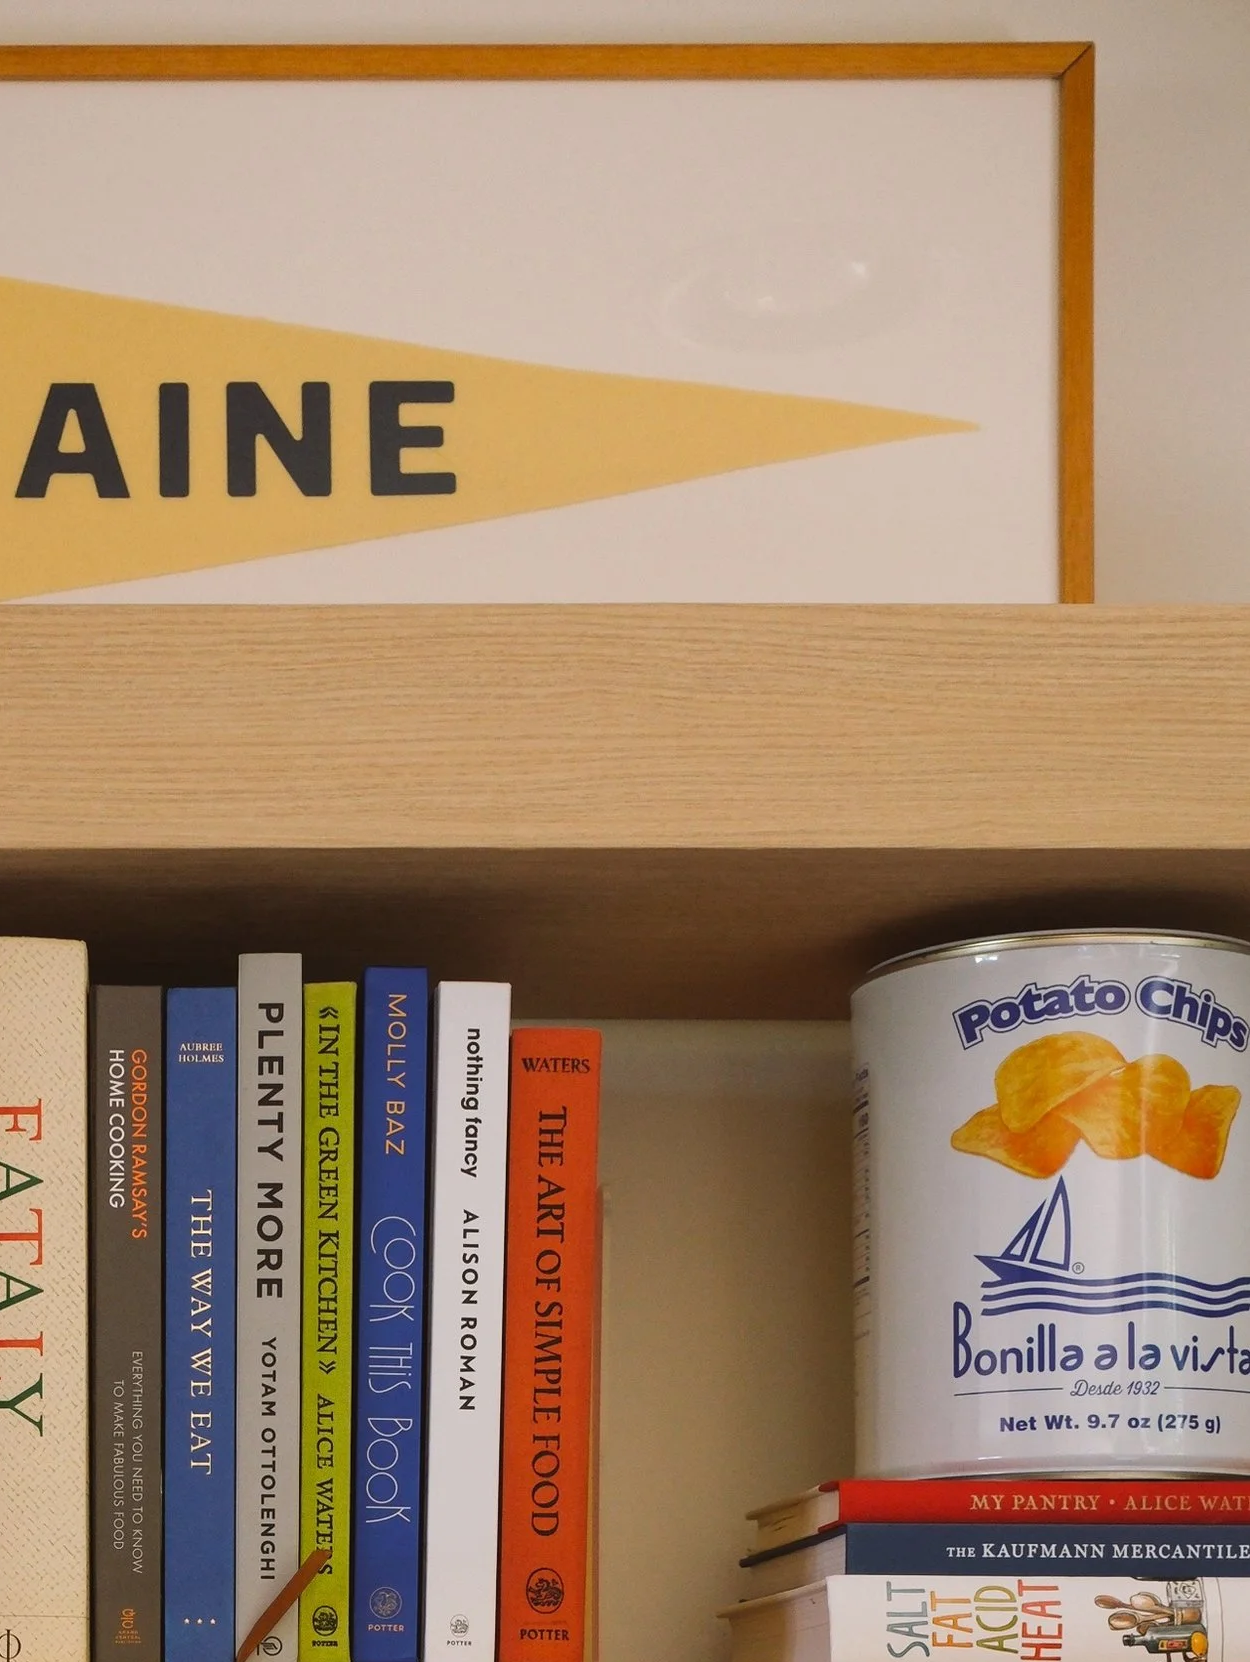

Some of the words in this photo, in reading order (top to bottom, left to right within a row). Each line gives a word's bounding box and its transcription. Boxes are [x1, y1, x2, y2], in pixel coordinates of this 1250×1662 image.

[386, 993, 407, 1089] MOLLY
[953, 974, 1130, 1051] Potato
[1134, 974, 1249, 1052] Chips
[109, 1049, 125, 1108] HOME
[177, 1054, 225, 1063] HOLMES
[178, 1043, 223, 1052] AUBREE
[461, 1027, 484, 1112] nothing
[521, 1057, 591, 1074] WATERS
[131, 1049, 147, 1139] GORDON
[257, 1003, 284, 1162] PLENTY
[318, 1061, 340, 1118] THE
[385, 1100, 406, 1155] BAZ
[460, 1117, 479, 1179] fancy
[537, 1105, 568, 1169] THE
[109, 1114, 125, 1209] COOKING
[131, 1143, 147, 1239] RAMSAY'S
[317, 1127, 340, 1221] GREEN
[190, 1189, 213, 1259] THE
[256, 1183, 283, 1299] MORE
[536, 1175, 566, 1244] ART
[461, 1208, 479, 1305] ALISON
[535, 1249, 563, 1293] OF
[190, 1268, 212, 1338] WAY
[459, 1316, 477, 1411] ROMAN
[532, 1300, 563, 1424] SIMPLE
[953, 1300, 1084, 1378] Bonilla
[1093, 1345, 1118, 1371] a
[1127, 1321, 1162, 1372] la
[113, 1379, 125, 1398] TO
[132, 1350, 143, 1430] EVERYTHING
[190, 1347, 212, 1398] WE
[261, 1336, 277, 1416] YOTAM
[1069, 1379, 1124, 1397] Desde
[1126, 1380, 1161, 1396] 1932
[113, 1403, 124, 1437] MAKE
[132, 1433, 143, 1463] YOU
[189, 1411, 212, 1476] EAT
[316, 1393, 334, 1469] ALICE
[999, 1416, 1037, 1432] Net
[1044, 1415, 1080, 1430] Wt.
[1086, 1414, 1120, 1429] 9.7
[1127, 1416, 1151, 1429] oz
[1157, 1414, 1200, 1433] (275
[1205, 1416, 1222, 1435] g)
[113, 1442, 124, 1507] FABULOUS
[132, 1467, 143, 1502] NEED
[260, 1428, 277, 1580] OTTOLENGHI
[531, 1432, 561, 1538] FOOD
[969, 1494, 1003, 1511] MY
[1012, 1494, 1100, 1511] PANTRY
[1124, 1495, 1192, 1511] ALICE
[113, 1510, 124, 1551] FOOD
[132, 1504, 143, 1525] TO
[132, 1528, 143, 1575] KNOW
[946, 1546, 976, 1558] THE
[981, 1543, 1106, 1559] KAUFMANN
[1111, 1543, 1250, 1559] MERCANTILE
[368, 1624, 405, 1632] POTTER
[519, 1629, 570, 1641] POTTER
[886, 1581, 931, 1659] SALT
[931, 1590, 973, 1649] FAT
[976, 1585, 1020, 1654] ACID
[1018, 1579, 1062, 1662] HEAT
